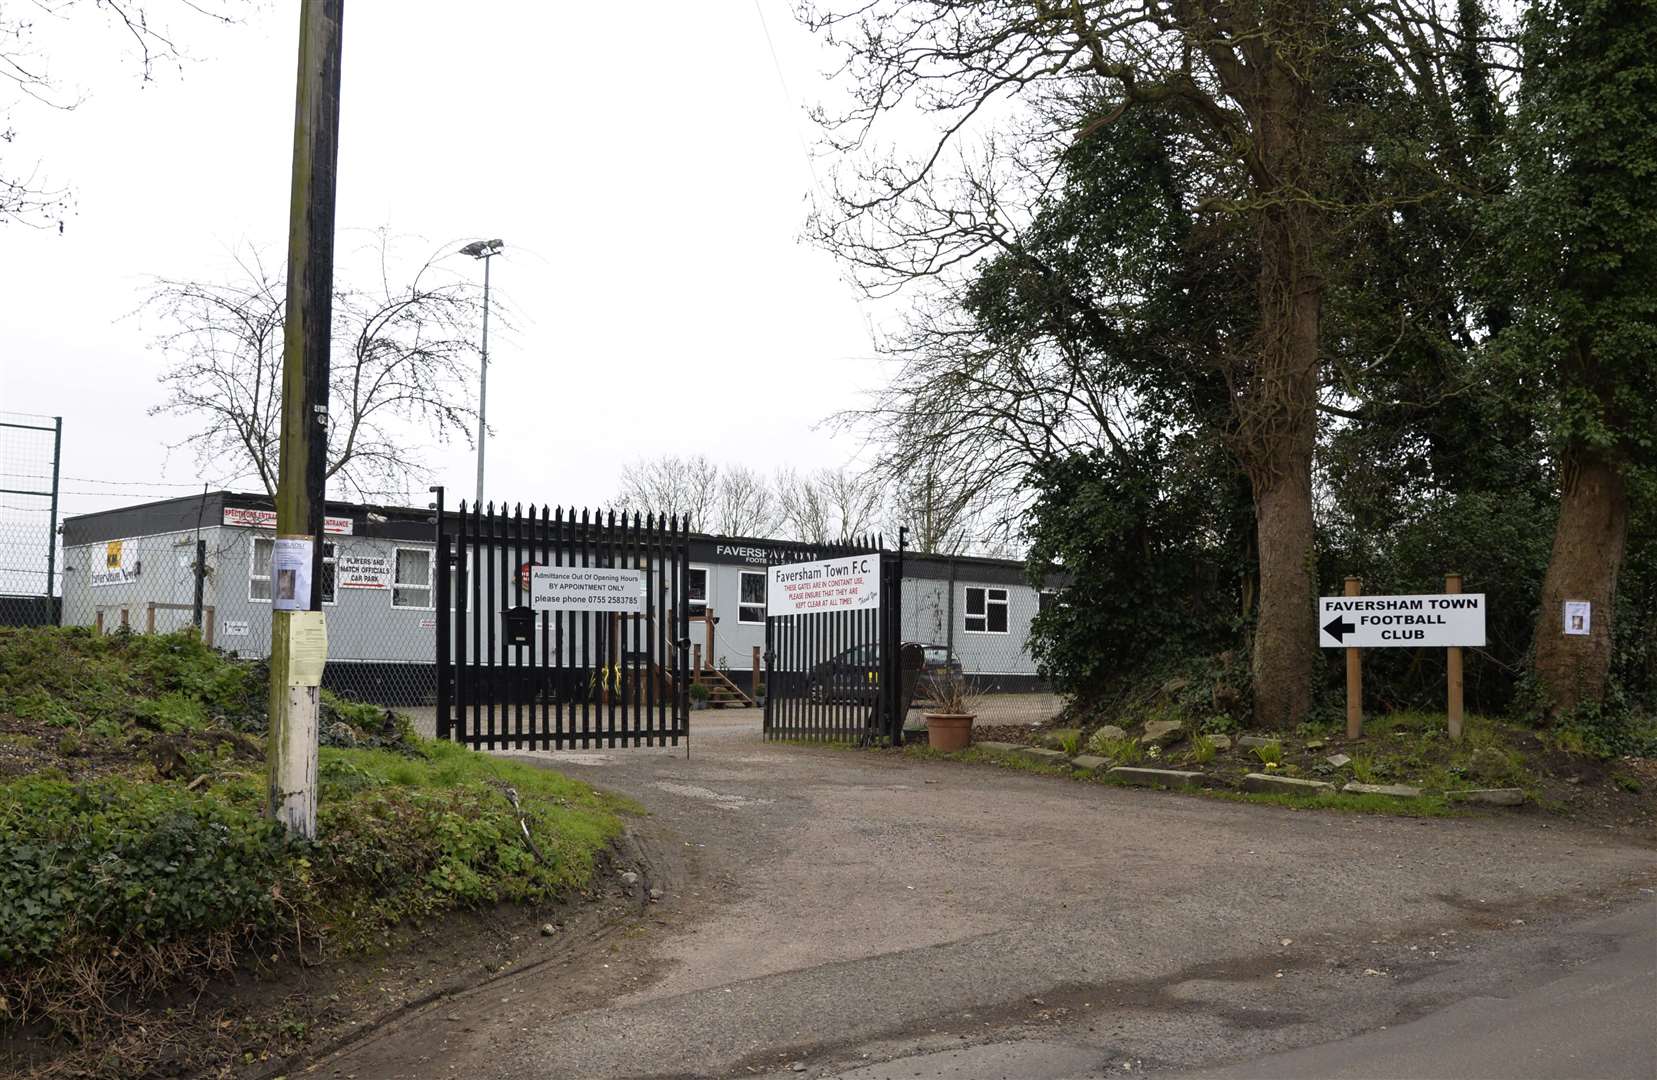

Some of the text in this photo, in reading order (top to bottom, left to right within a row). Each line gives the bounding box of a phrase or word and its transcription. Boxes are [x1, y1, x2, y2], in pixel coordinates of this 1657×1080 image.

[324, 519, 349, 528] NTRANCE
[346, 558, 372, 566] PLAYERS
[360, 566, 390, 574] OFFICIALS
[776, 560, 871, 582] Faversham Town F.C.
[534, 572, 570, 580] Admittance
[594, 574, 619, 582] Opening
[828, 578, 853, 588] CONSTANT
[788, 592, 804, 600] PLEASE
[805, 590, 821, 600] ENSURE
[822, 590, 834, 598] THAT
[836, 588, 848, 596] THEY
[534, 595, 560, 603] please
[562, 596, 586, 604] phone
[608, 596, 638, 604] 2583785
[1325, 599, 1478, 612] FAVERSHAM TOWN
[1360, 615, 1446, 626] FOOTBALL
[1381, 630, 1424, 640] CLUB
